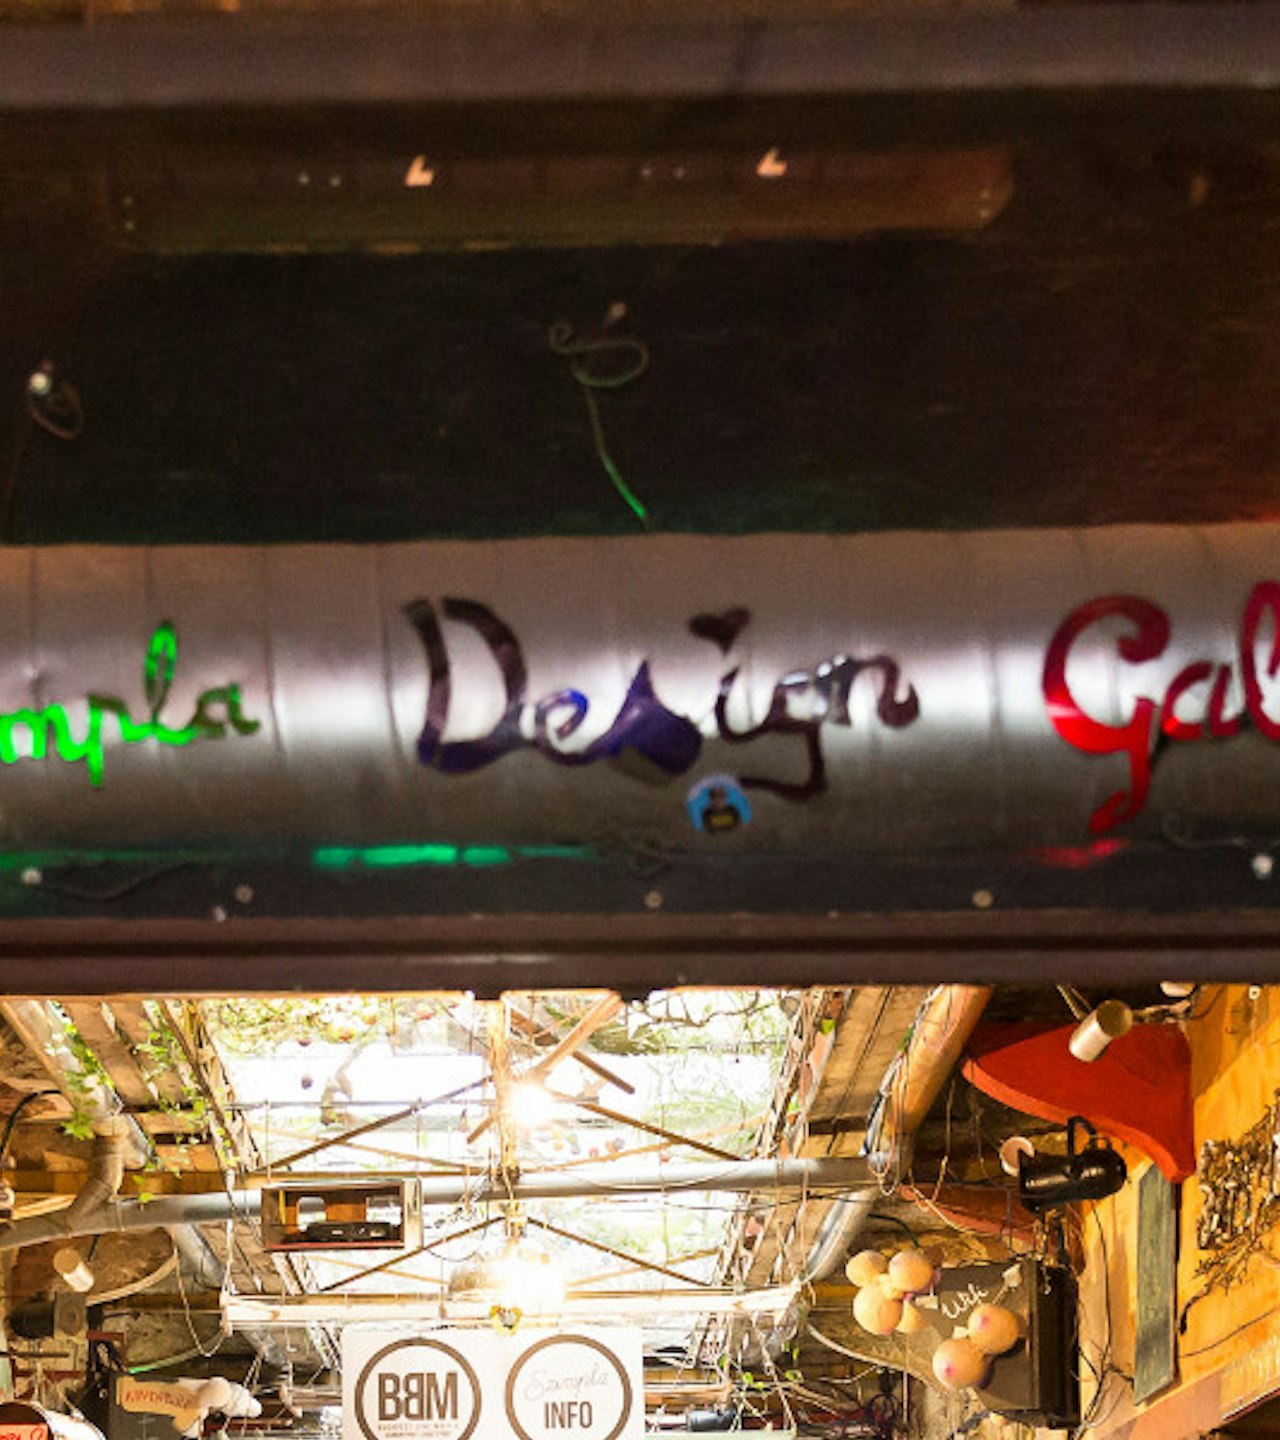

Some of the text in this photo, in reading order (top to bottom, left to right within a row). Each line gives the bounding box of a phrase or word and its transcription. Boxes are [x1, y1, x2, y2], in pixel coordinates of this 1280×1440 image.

[403, 595, 921, 800] Design
[378, 1372, 458, 1420] BBM
[544, 1401, 593, 1430] INFO
